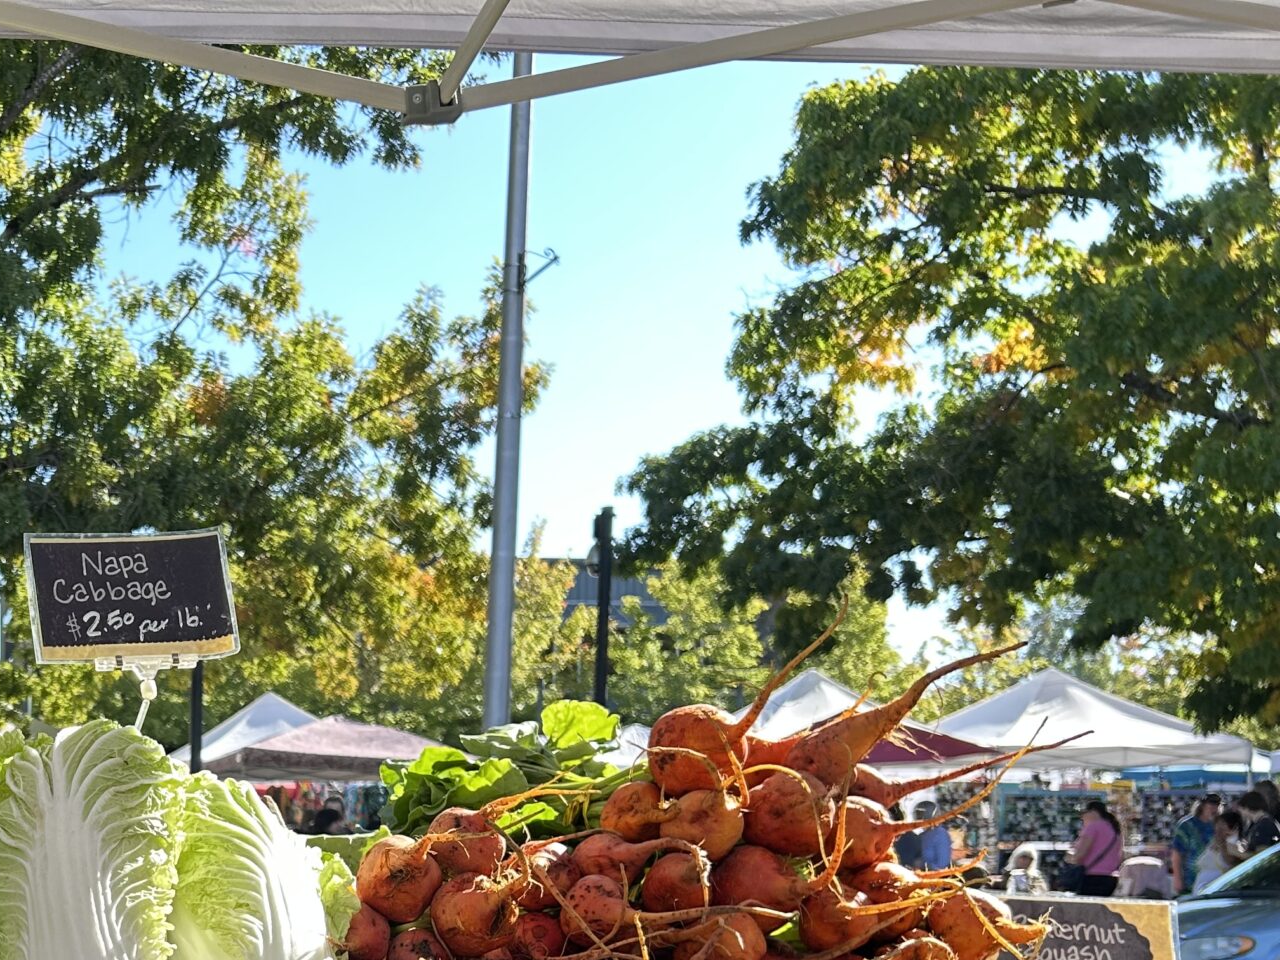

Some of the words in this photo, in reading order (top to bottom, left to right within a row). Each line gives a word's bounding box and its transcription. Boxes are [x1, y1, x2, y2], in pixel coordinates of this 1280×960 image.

[81, 551, 149, 578] Napa
[53, 578, 172, 606] Cabbage
[66, 608, 135, 641] $2.50
[139, 617, 169, 641] per
